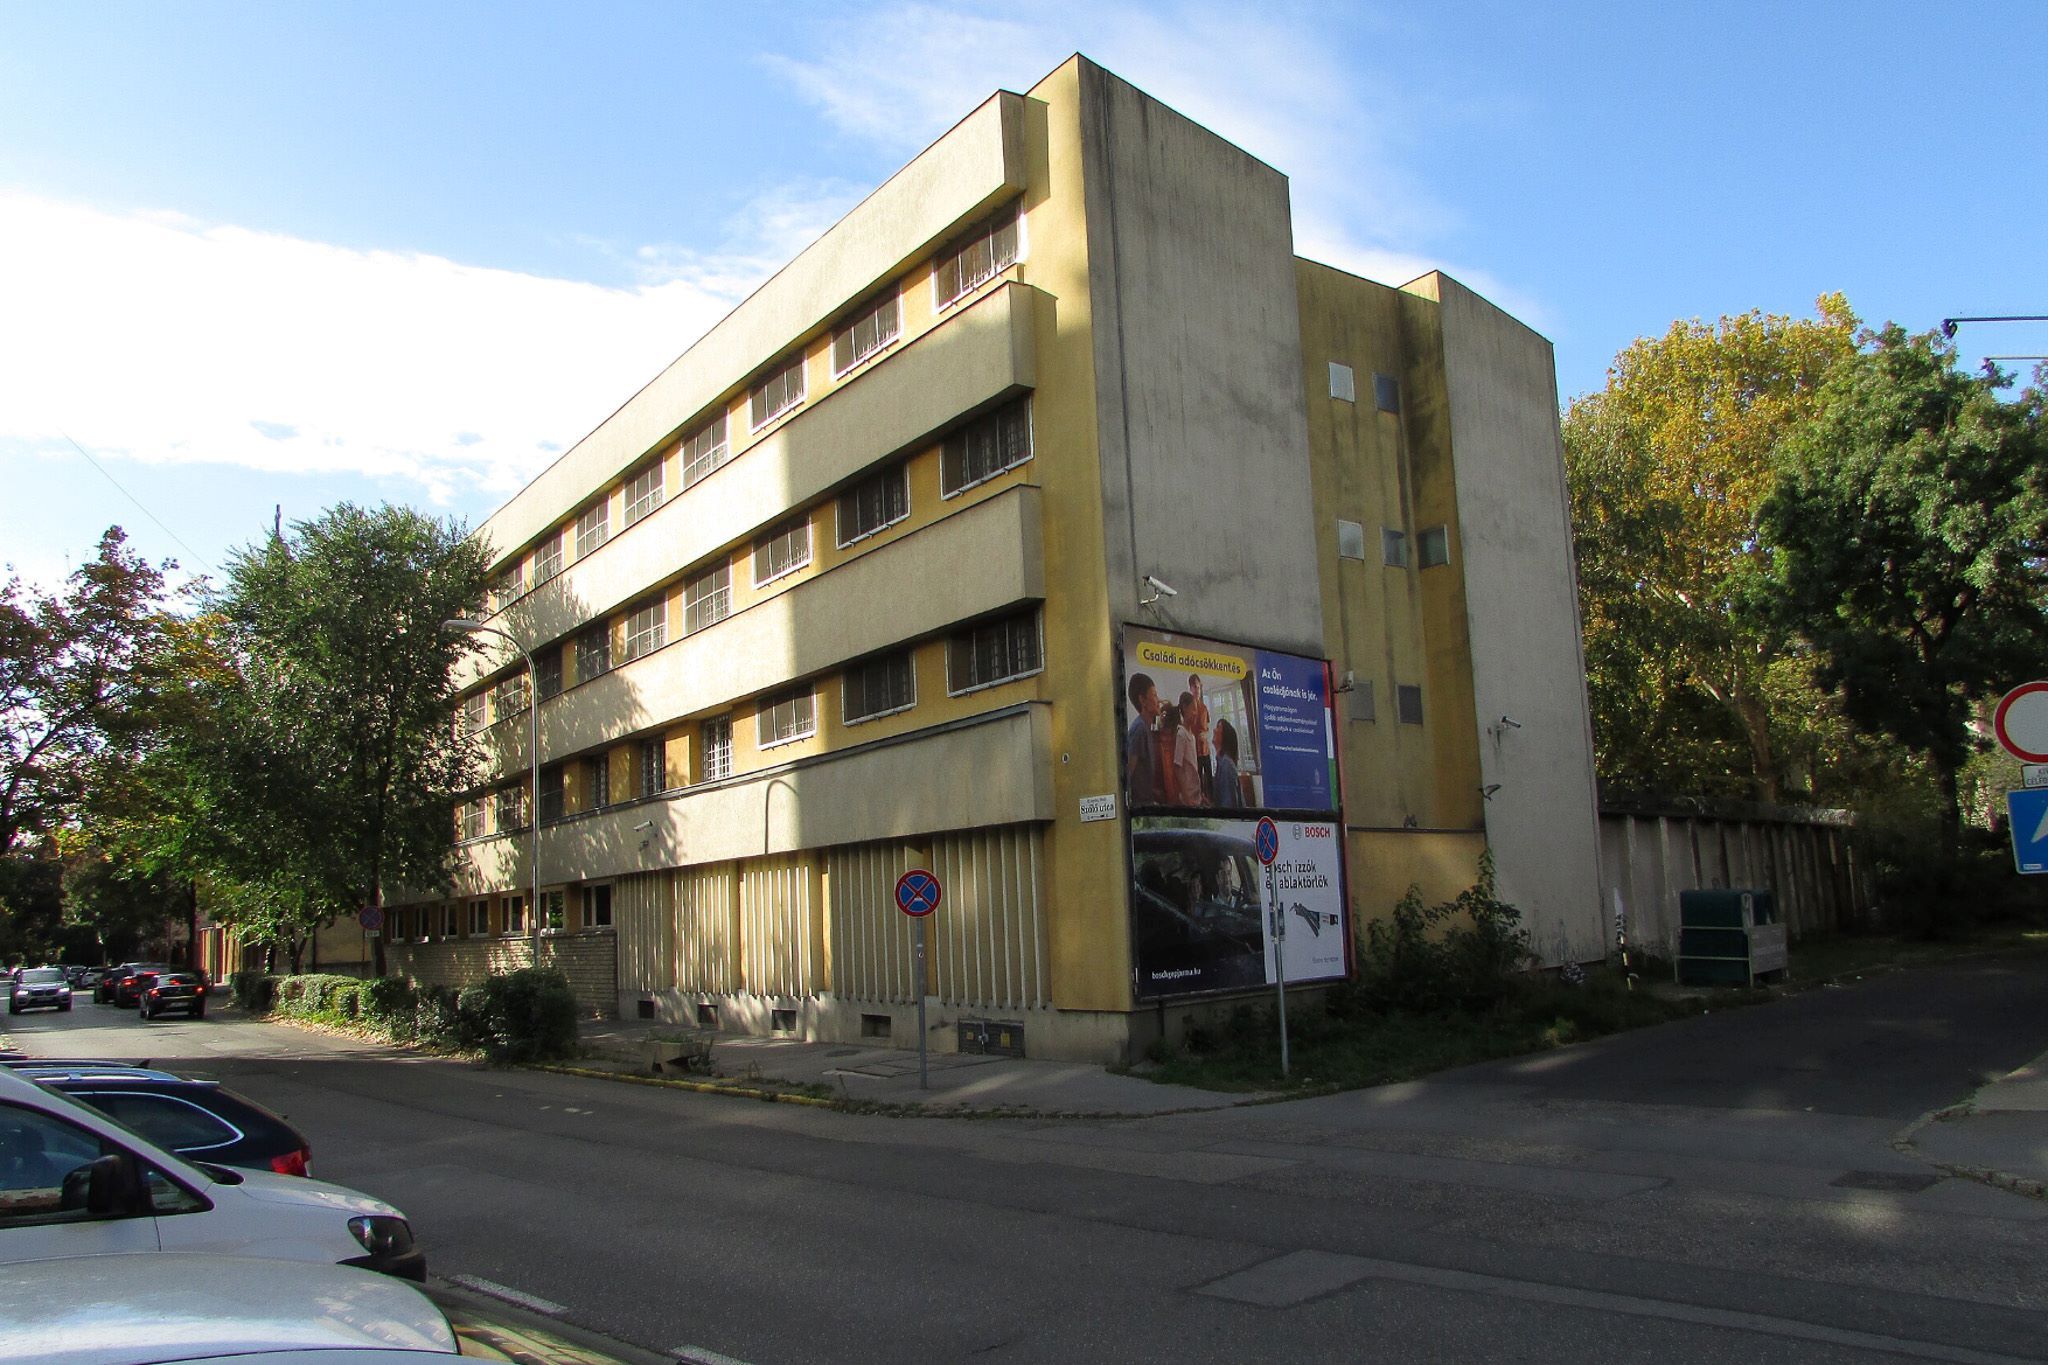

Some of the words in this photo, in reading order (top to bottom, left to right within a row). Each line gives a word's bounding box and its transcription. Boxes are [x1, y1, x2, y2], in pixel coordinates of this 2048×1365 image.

[1143, 648, 1177, 664] Családi
[1178, 655, 1241, 674] adócsökkentés
[1262, 668, 1271, 678] Az
[1302, 689, 1307, 699] is
[1100, 803, 1114, 812] utca
[1305, 827, 1331, 838] BOSCH
[1295, 859, 1316, 873] izzók
[1280, 875, 1328, 889] ablaktörlők
